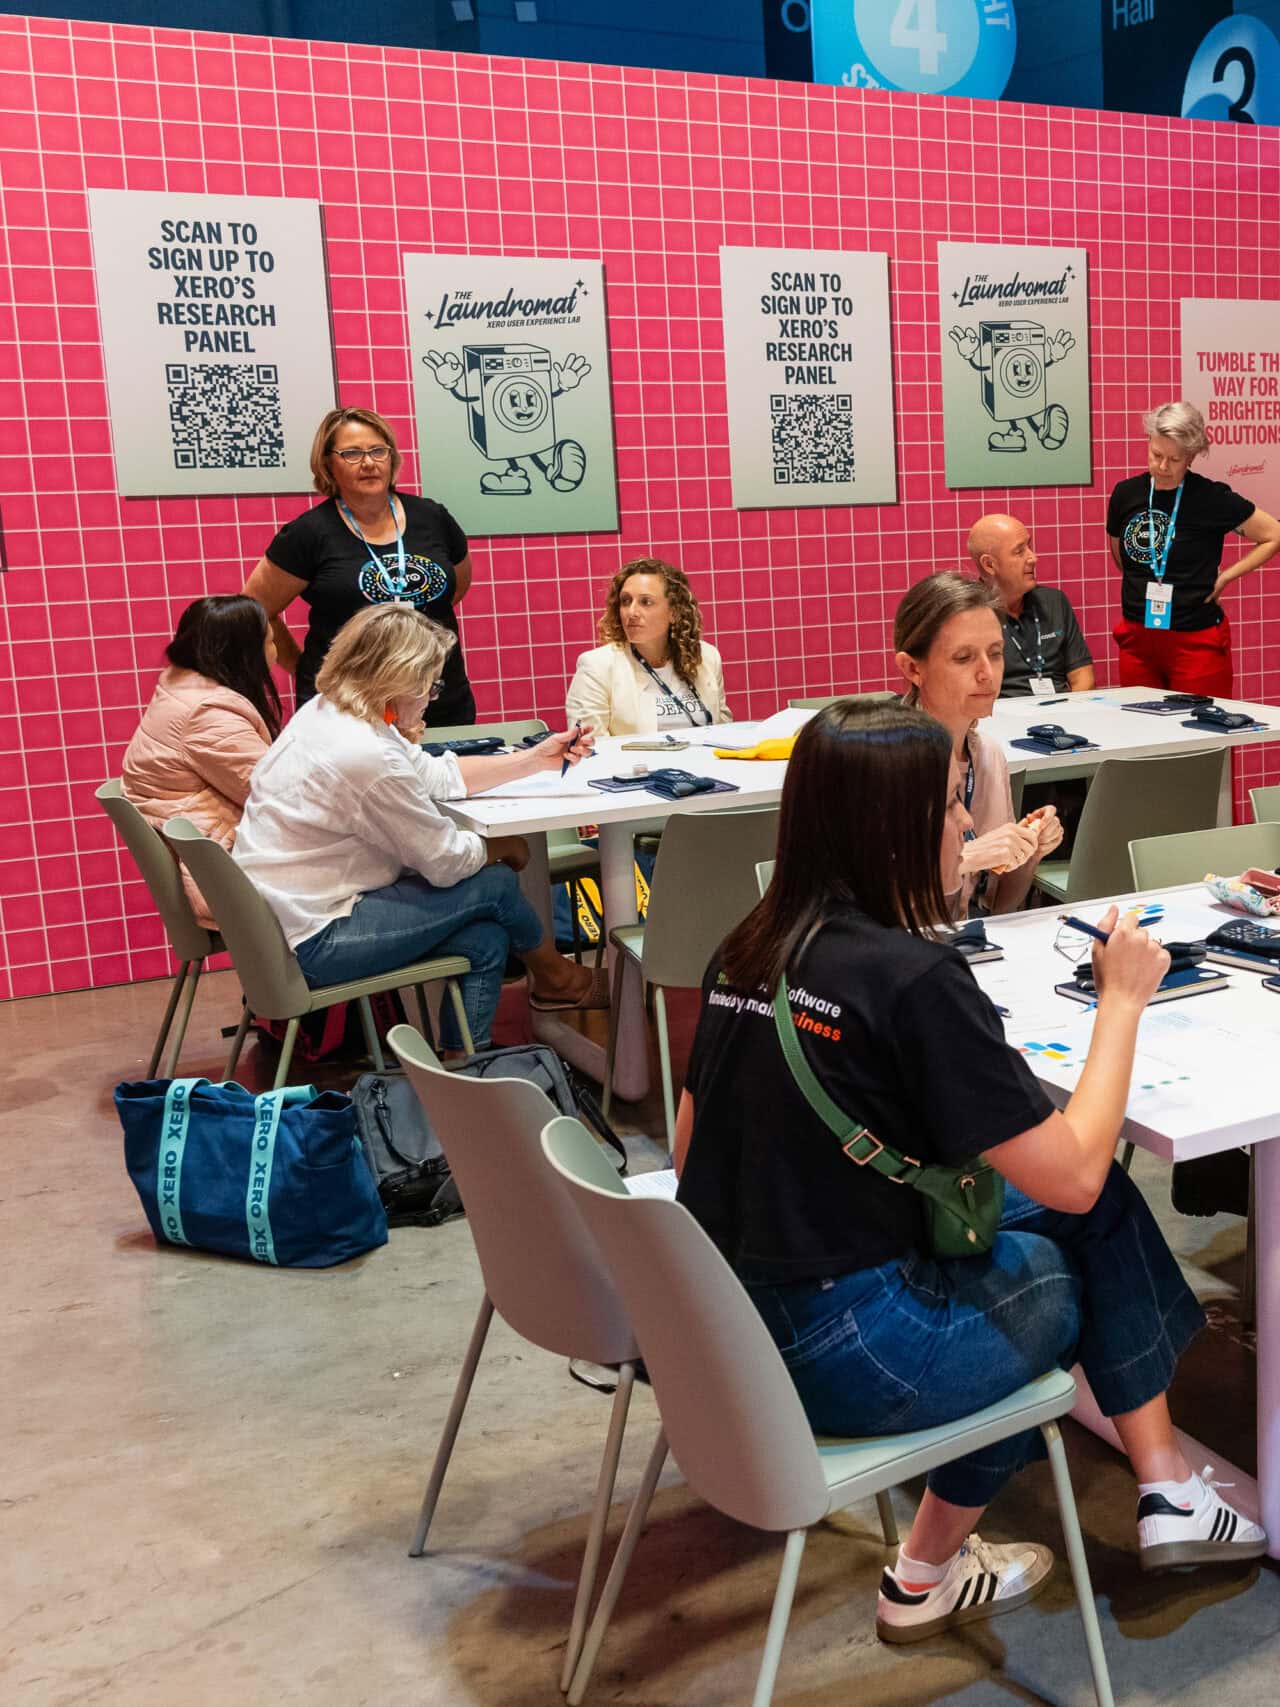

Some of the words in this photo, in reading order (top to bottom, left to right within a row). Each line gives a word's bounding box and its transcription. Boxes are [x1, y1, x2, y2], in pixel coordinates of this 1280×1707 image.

[889, 0, 947, 75] 4
[161, 220, 222, 244] SCAN
[228, 222, 257, 245] TO
[148, 247, 201, 270] SIGN
[208, 249, 239, 272] UP
[245, 251, 274, 272] TO
[174, 275, 256, 299] XERO'S
[771, 272, 815, 291] SCAN
[820, 273, 841, 292] TO
[958, 272, 1067, 307] Laundromat
[454, 291, 472, 300] THE
[761, 295, 800, 315] SIGN
[805, 296, 827, 315] UP
[831, 297, 853, 316] TO
[157, 302, 276, 326] RESEARCH
[434, 288, 577, 329] Laundromat
[507, 319, 525, 327] USER
[526, 316, 566, 326] EXPERIENCE
[568, 315, 580, 323] LAB
[779, 319, 838, 338] XERO'S
[184, 330, 256, 353] PANEL
[766, 342, 852, 362] RESEARCH
[1197, 352, 1256, 372] TUMBLE
[785, 366, 837, 385] PANEL
[1213, 377, 1245, 397] WAY
[1250, 377, 1278, 397] FOR
[786, 985, 842, 1018] oftware
[792, 1011, 842, 1041] iness
[167, 1084, 186, 1140] XERO
[257, 1096, 278, 1151] XERO
[163, 1150, 178, 1206] XERO
[250, 1162, 267, 1218] XERO
